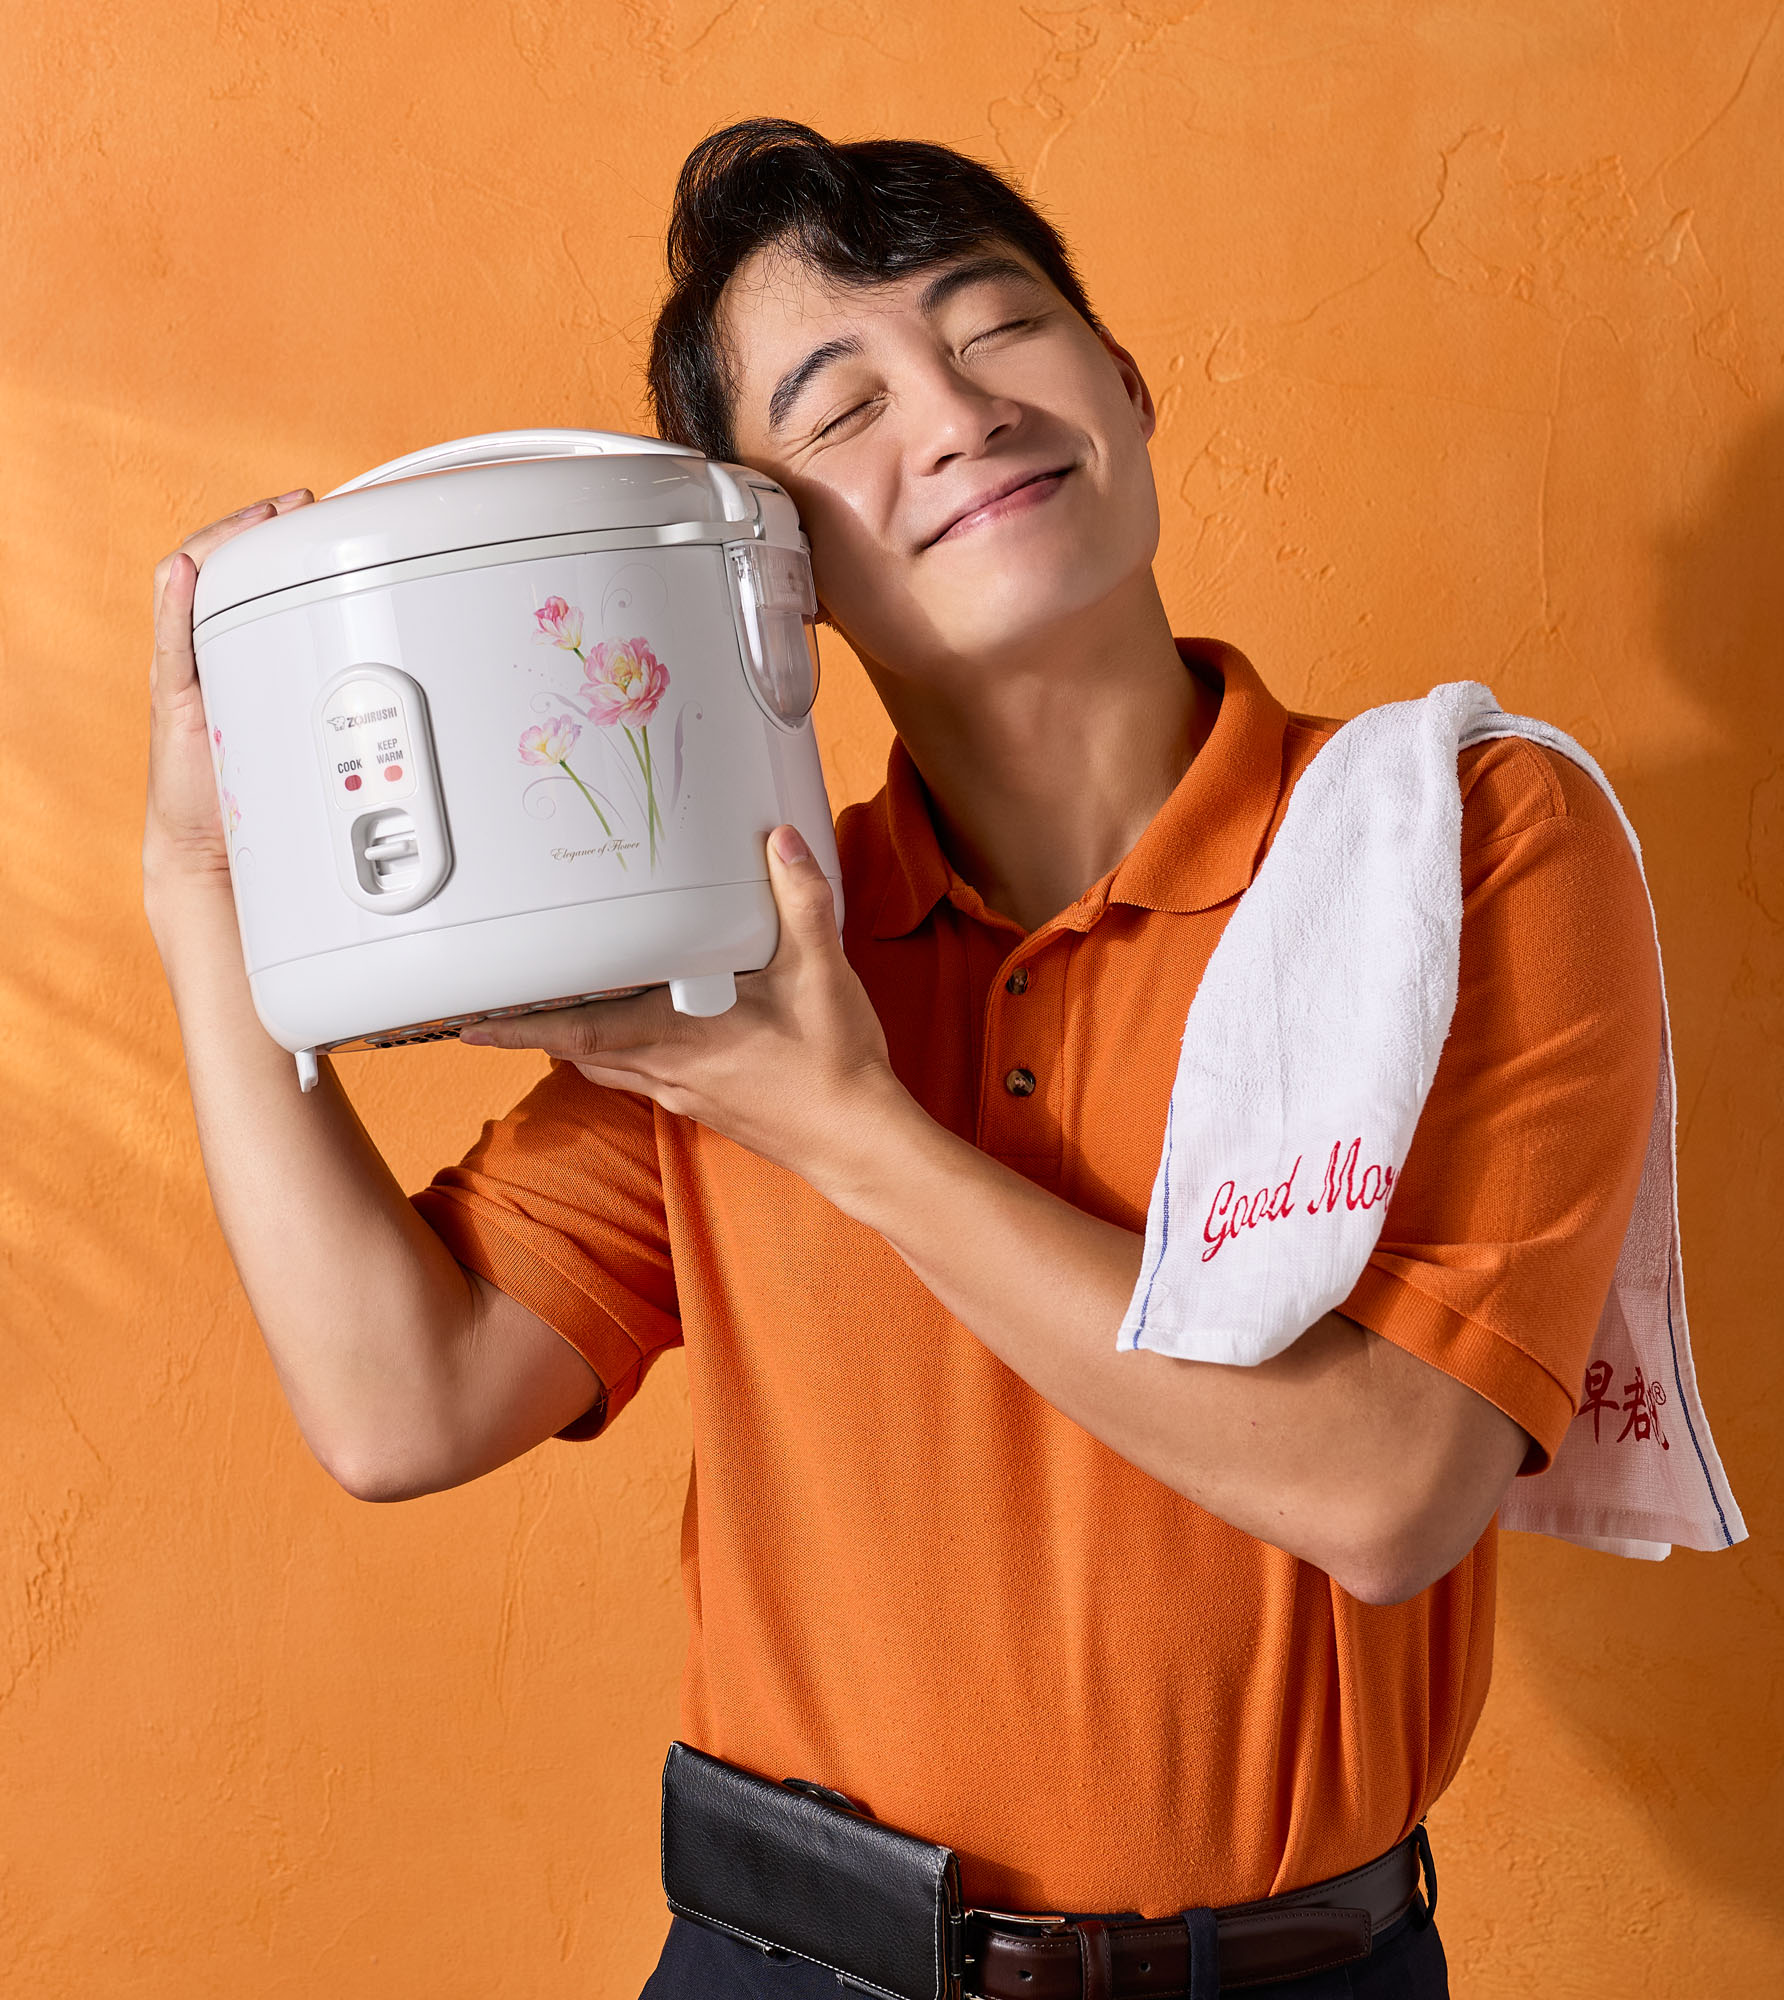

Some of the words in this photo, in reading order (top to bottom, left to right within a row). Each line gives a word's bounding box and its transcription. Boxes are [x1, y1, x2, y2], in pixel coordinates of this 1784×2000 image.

[346, 706, 398, 728] ZOJIRUSHI
[377, 738, 398, 751] KEEP
[337, 758, 363, 774] COOK
[376, 750, 404, 765] WARM
[550, 847, 597, 863] Elegance
[597, 843, 608, 858] of
[607, 839, 641, 853] Flower
[1201, 1154, 1303, 1263] Good
